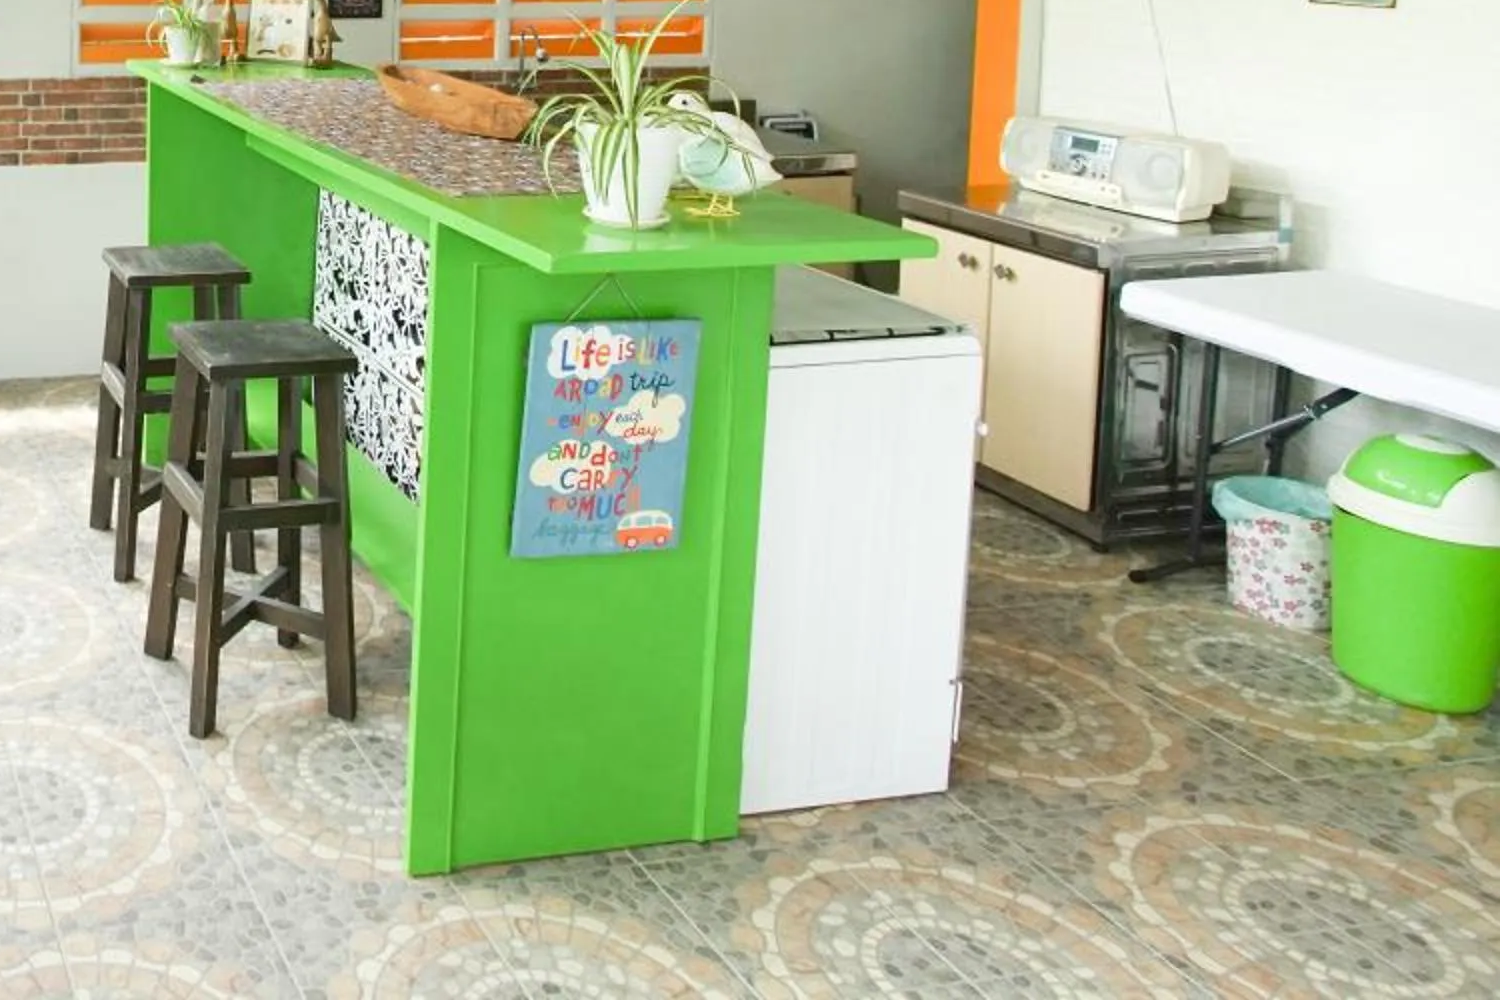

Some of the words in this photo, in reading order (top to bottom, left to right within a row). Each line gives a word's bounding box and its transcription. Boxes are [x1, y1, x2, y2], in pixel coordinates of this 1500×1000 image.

[561, 337, 612, 371] Life
[618, 337, 636, 361] is
[629, 371, 675, 408] trip
